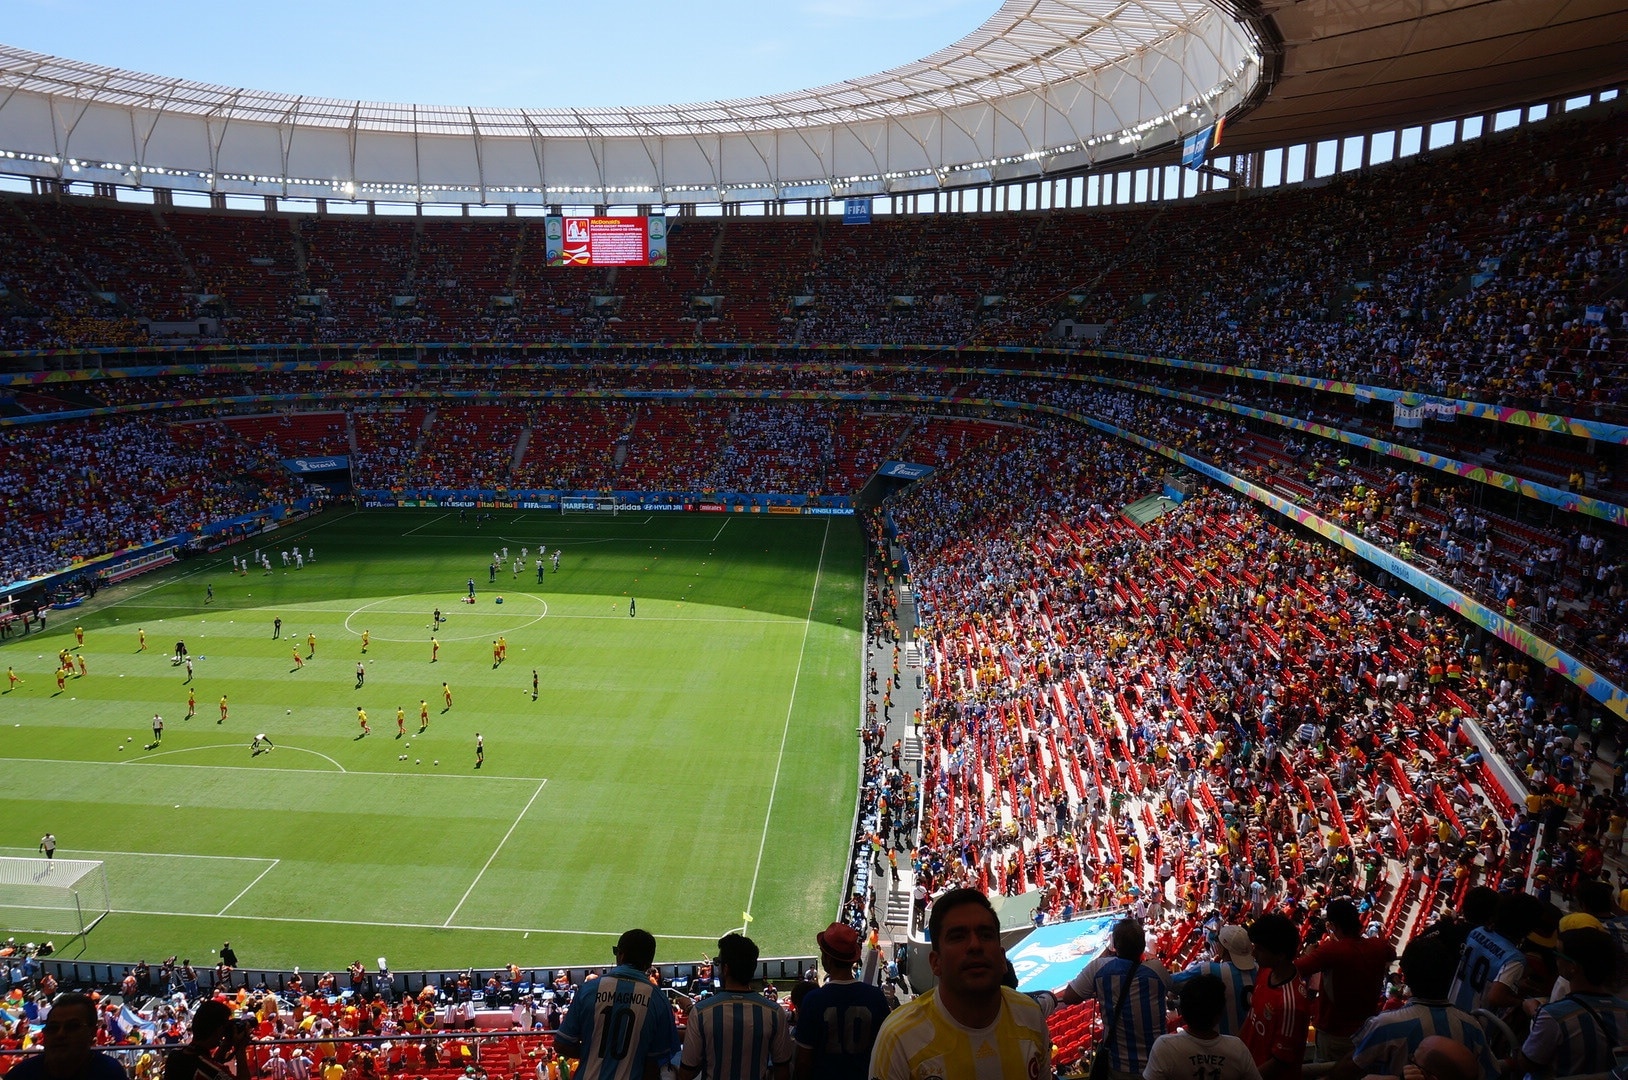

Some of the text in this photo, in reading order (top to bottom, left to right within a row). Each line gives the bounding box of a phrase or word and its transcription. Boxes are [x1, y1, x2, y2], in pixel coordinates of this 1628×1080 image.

[848, 205, 866, 214] FIFA
[595, 992, 651, 1008] ROMAGNOLI
[598, 1006, 636, 1060] 10
[823, 1006, 872, 1054] 10
[1189, 1055, 1226, 1066] TEVEZ
